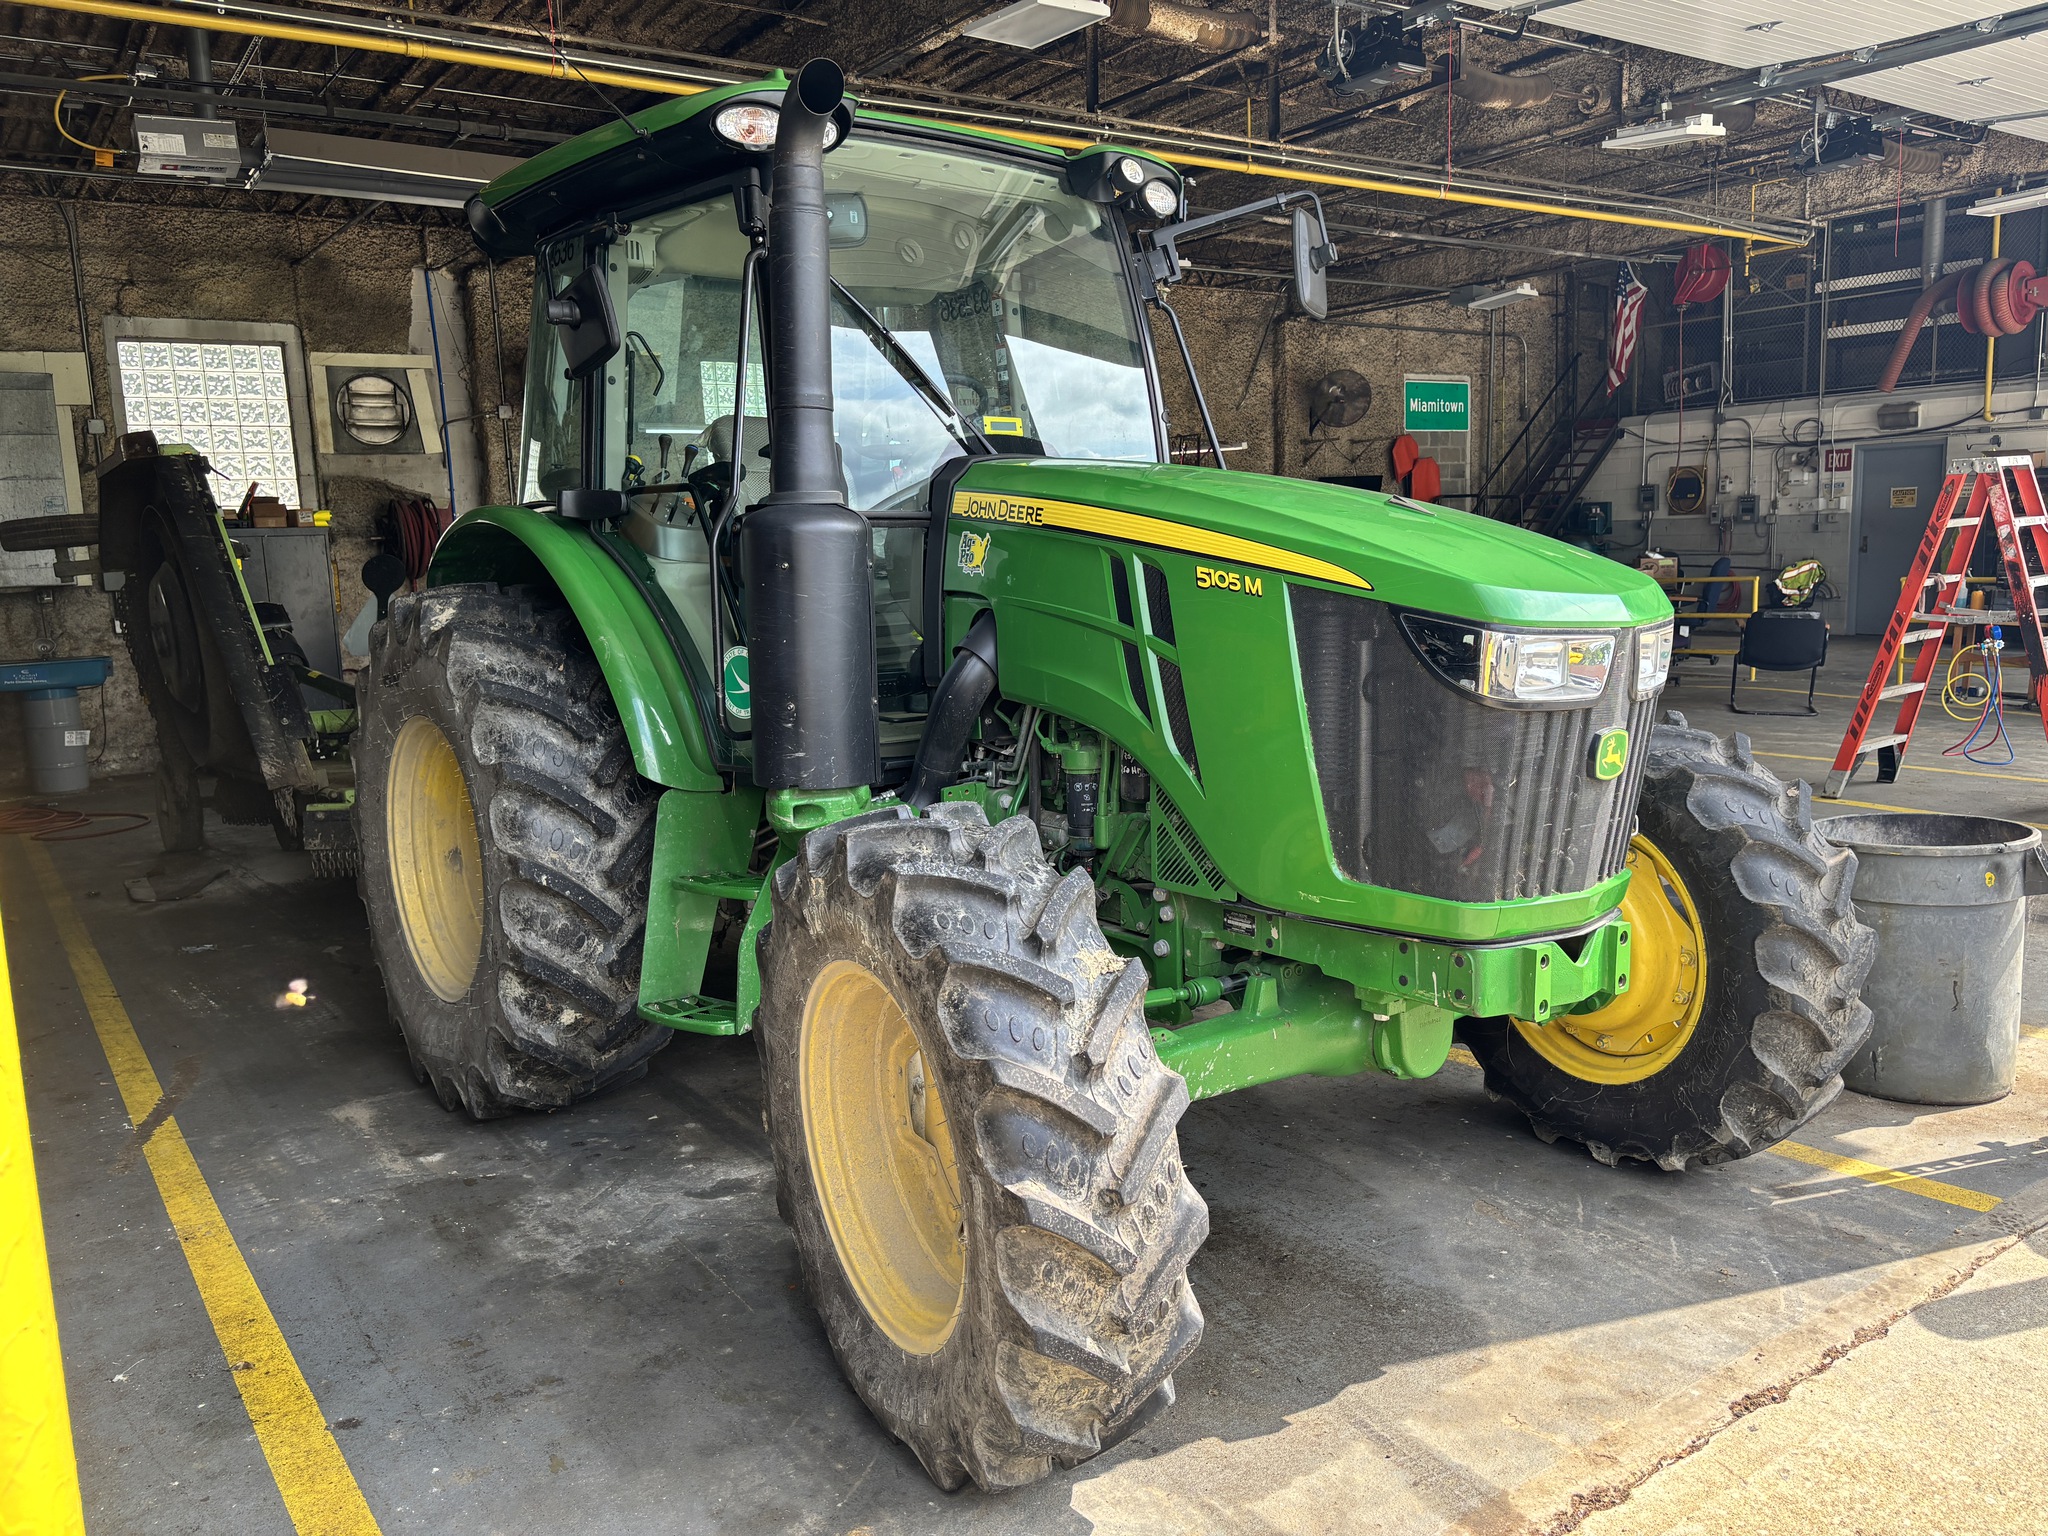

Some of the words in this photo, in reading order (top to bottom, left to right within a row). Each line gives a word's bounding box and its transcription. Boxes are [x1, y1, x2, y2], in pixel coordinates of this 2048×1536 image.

[1410, 398, 1464, 413] Miamitown
[1828, 453, 1849, 468] EXIT
[963, 497, 997, 517] JOHN
[998, 499, 1044, 522] DEERE
[959, 549, 975, 564] Pro
[1195, 565, 1242, 592] 5105
[1244, 575, 1263, 597] M
